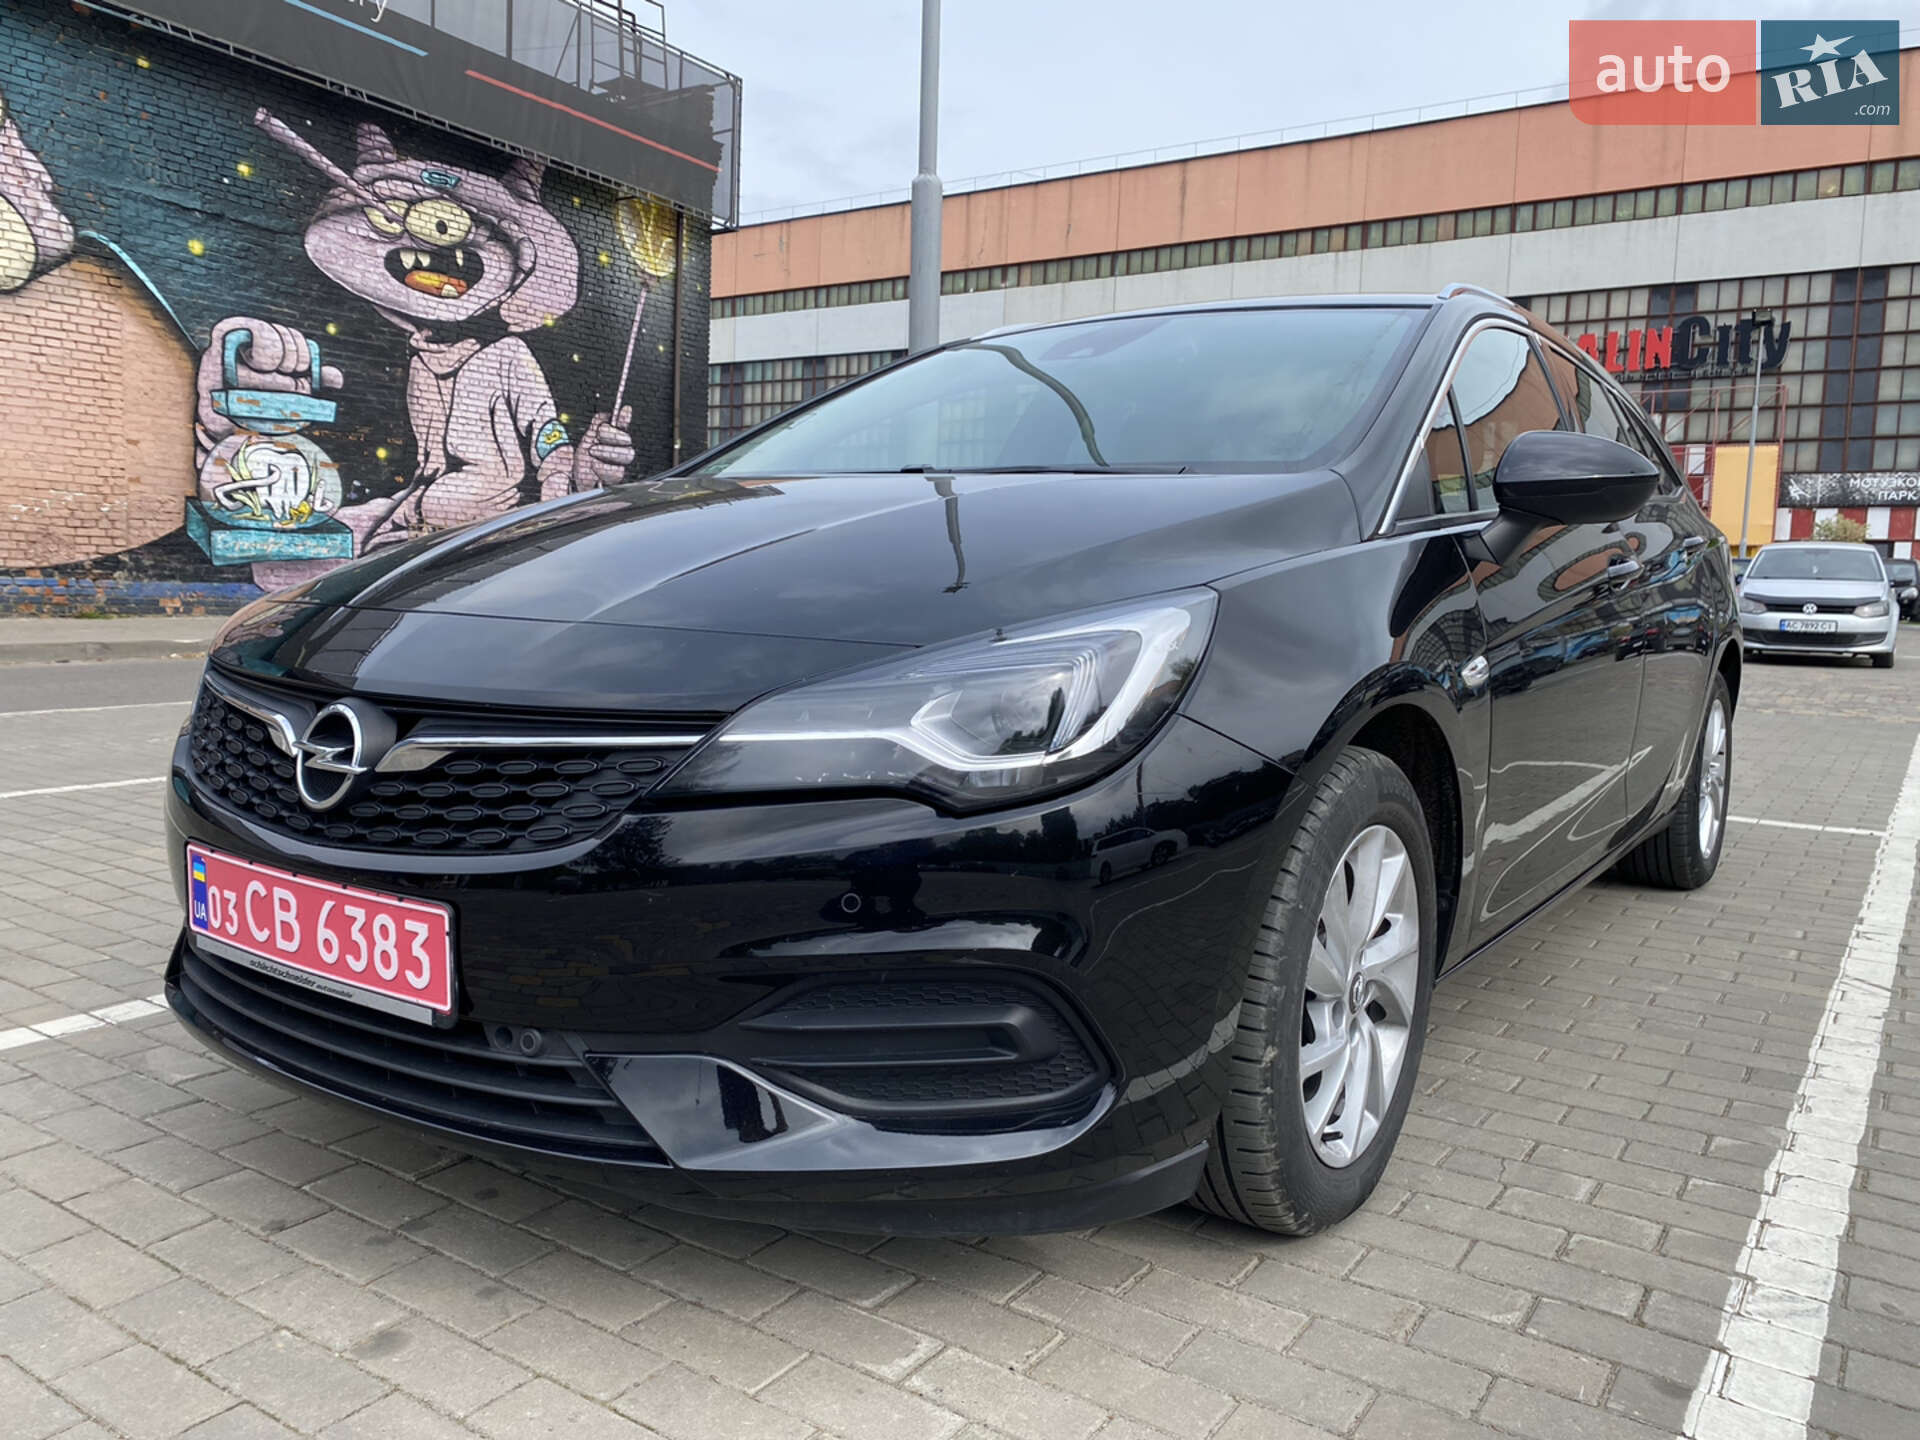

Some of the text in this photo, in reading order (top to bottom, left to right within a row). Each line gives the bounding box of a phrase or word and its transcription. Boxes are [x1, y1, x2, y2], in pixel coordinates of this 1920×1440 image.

[1850, 476, 1920, 489] МОТУЗКО
[1878, 490, 1919, 501] ПАРК
[194, 899, 208, 922] UA
[208, 880, 432, 990] 03 CB 6383
